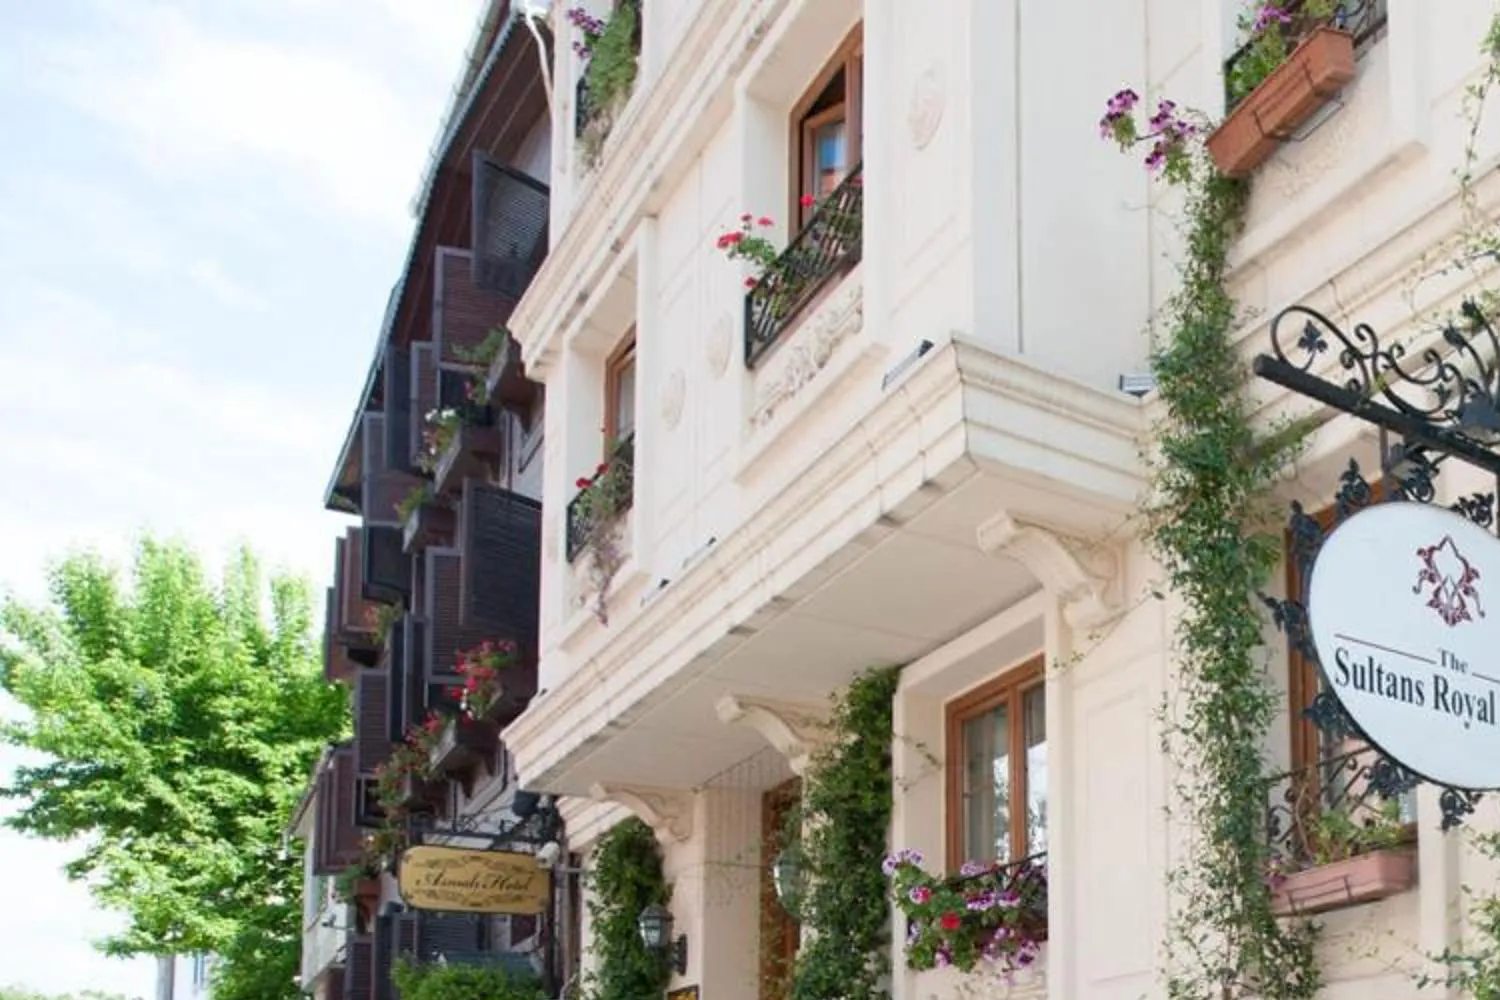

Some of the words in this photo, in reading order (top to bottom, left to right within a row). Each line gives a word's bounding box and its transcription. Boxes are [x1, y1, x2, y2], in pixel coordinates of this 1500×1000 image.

[1334, 646, 1426, 707] Sultans
[1433, 674, 1495, 729] Royal
[1438, 648, 1469, 674] The
